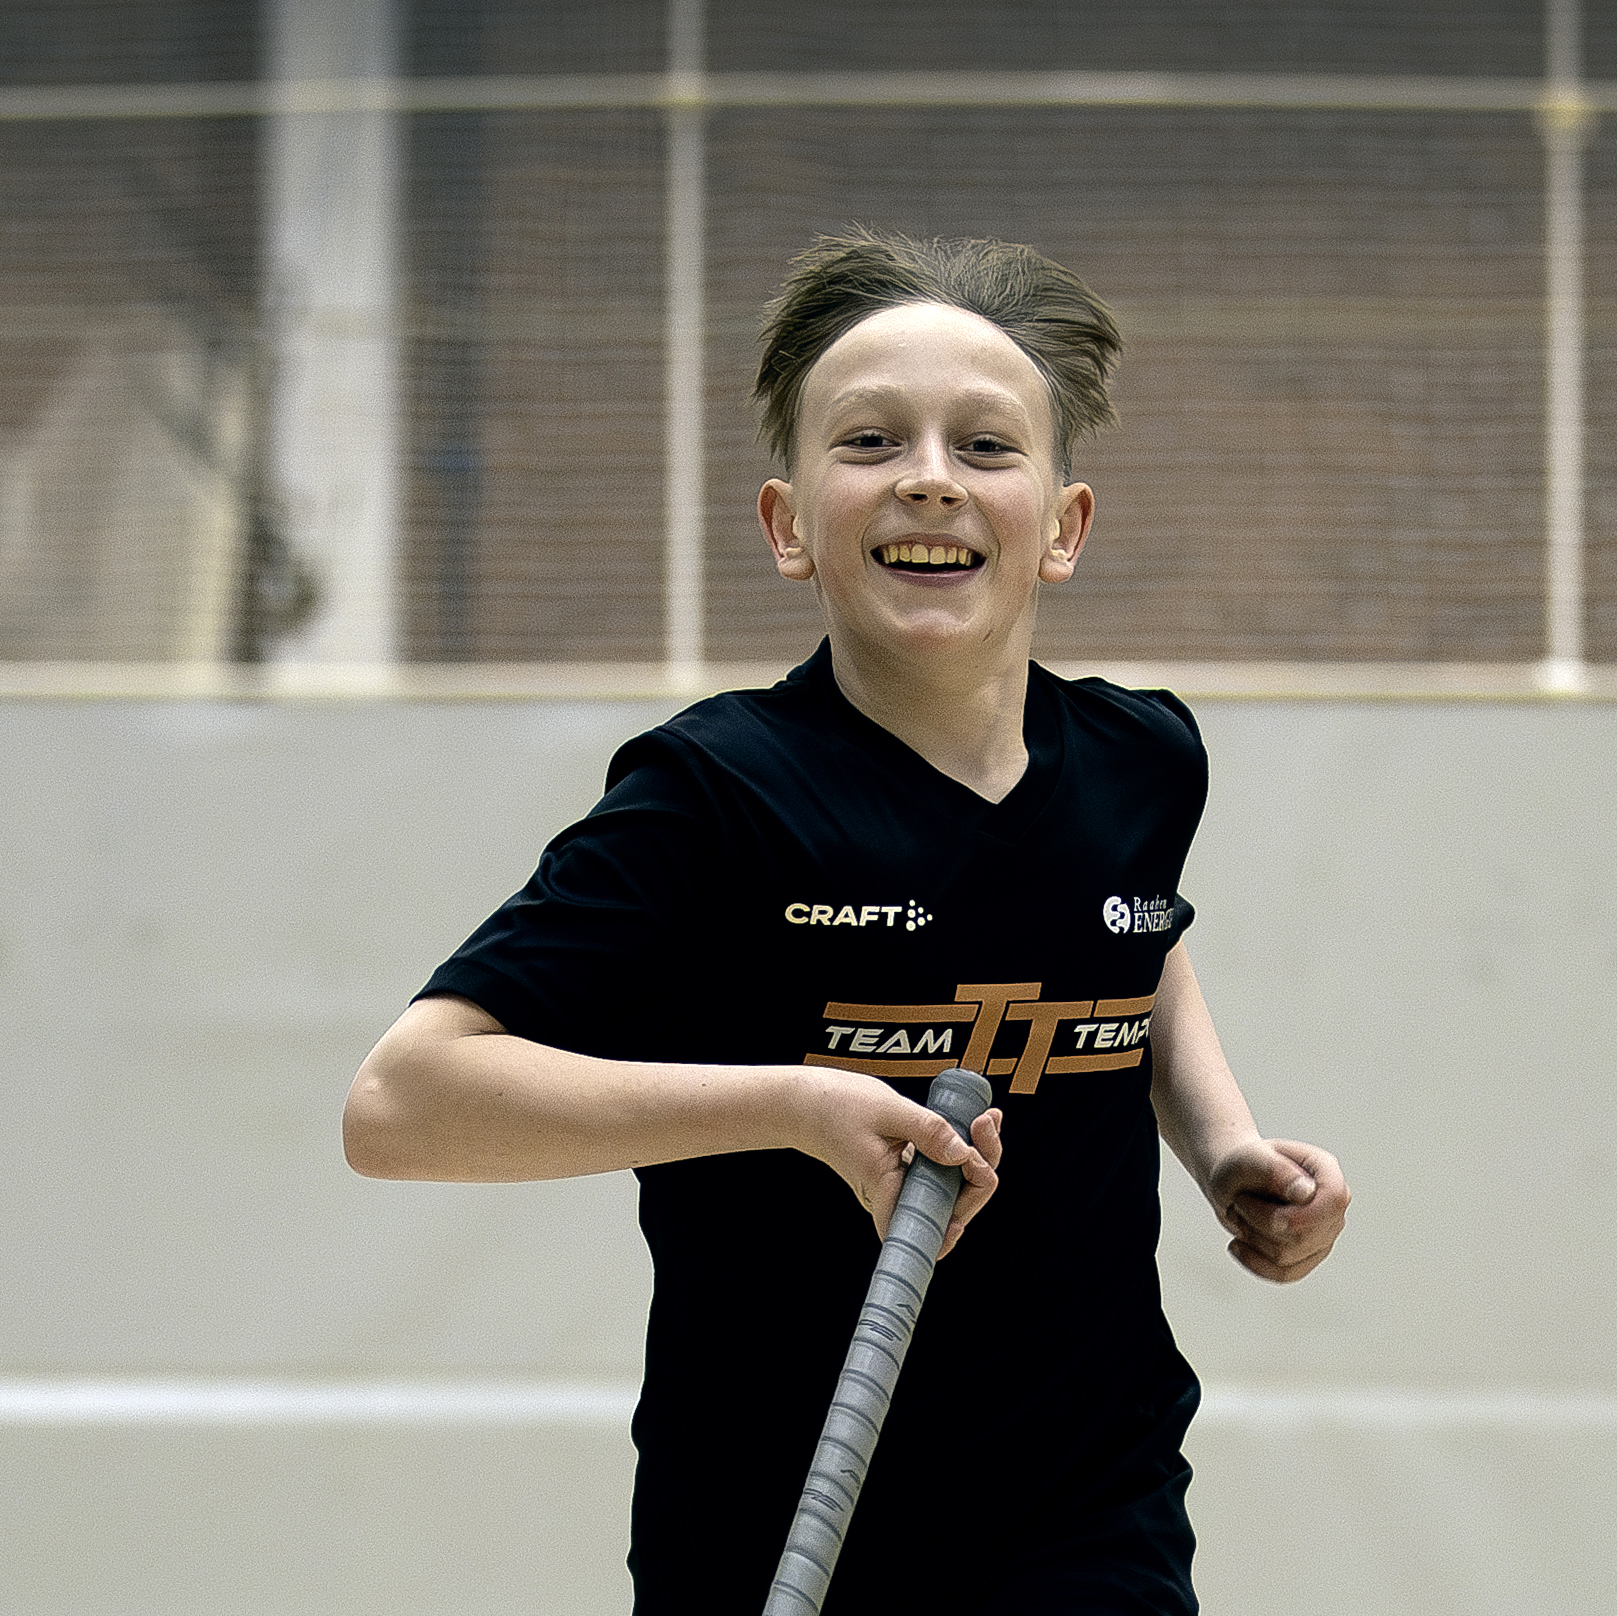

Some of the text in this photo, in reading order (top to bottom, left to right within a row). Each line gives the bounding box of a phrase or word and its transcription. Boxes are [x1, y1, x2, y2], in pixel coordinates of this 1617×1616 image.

[784, 903, 903, 927] CRAFT
[825, 1025, 953, 1054] TEAM
[1073, 1018, 1151, 1049] TEMP
